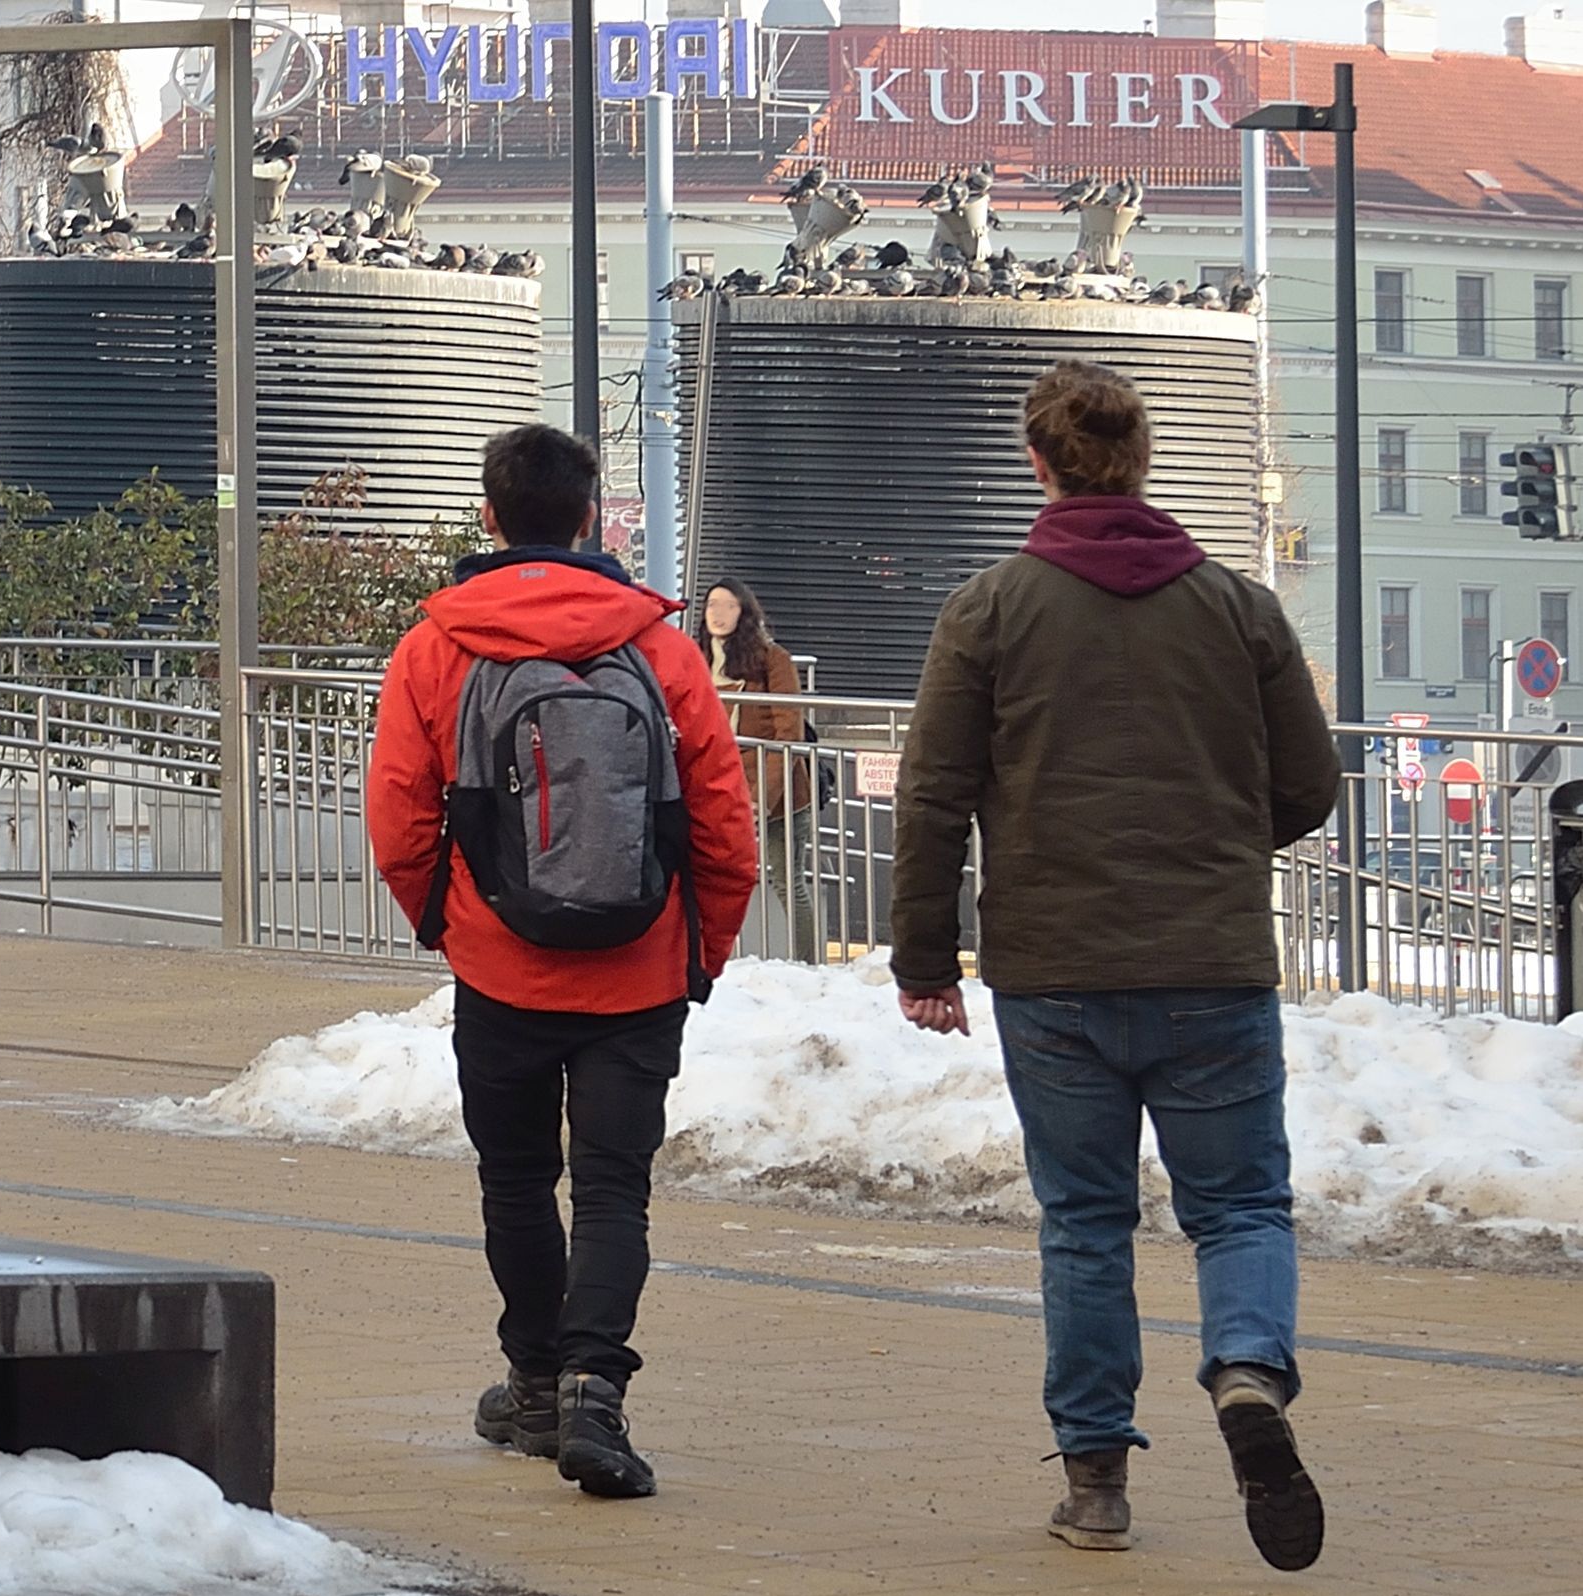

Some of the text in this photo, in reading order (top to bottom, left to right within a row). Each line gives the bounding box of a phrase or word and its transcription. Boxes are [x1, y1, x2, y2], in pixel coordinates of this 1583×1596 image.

[346, 18, 755, 104] HYUNDAI
[854, 66, 1231, 130] KURIER
[1528, 703, 1549, 716] Ende
[862, 756, 898, 768] FAHRRA
[865, 769, 898, 780] ABSTE
